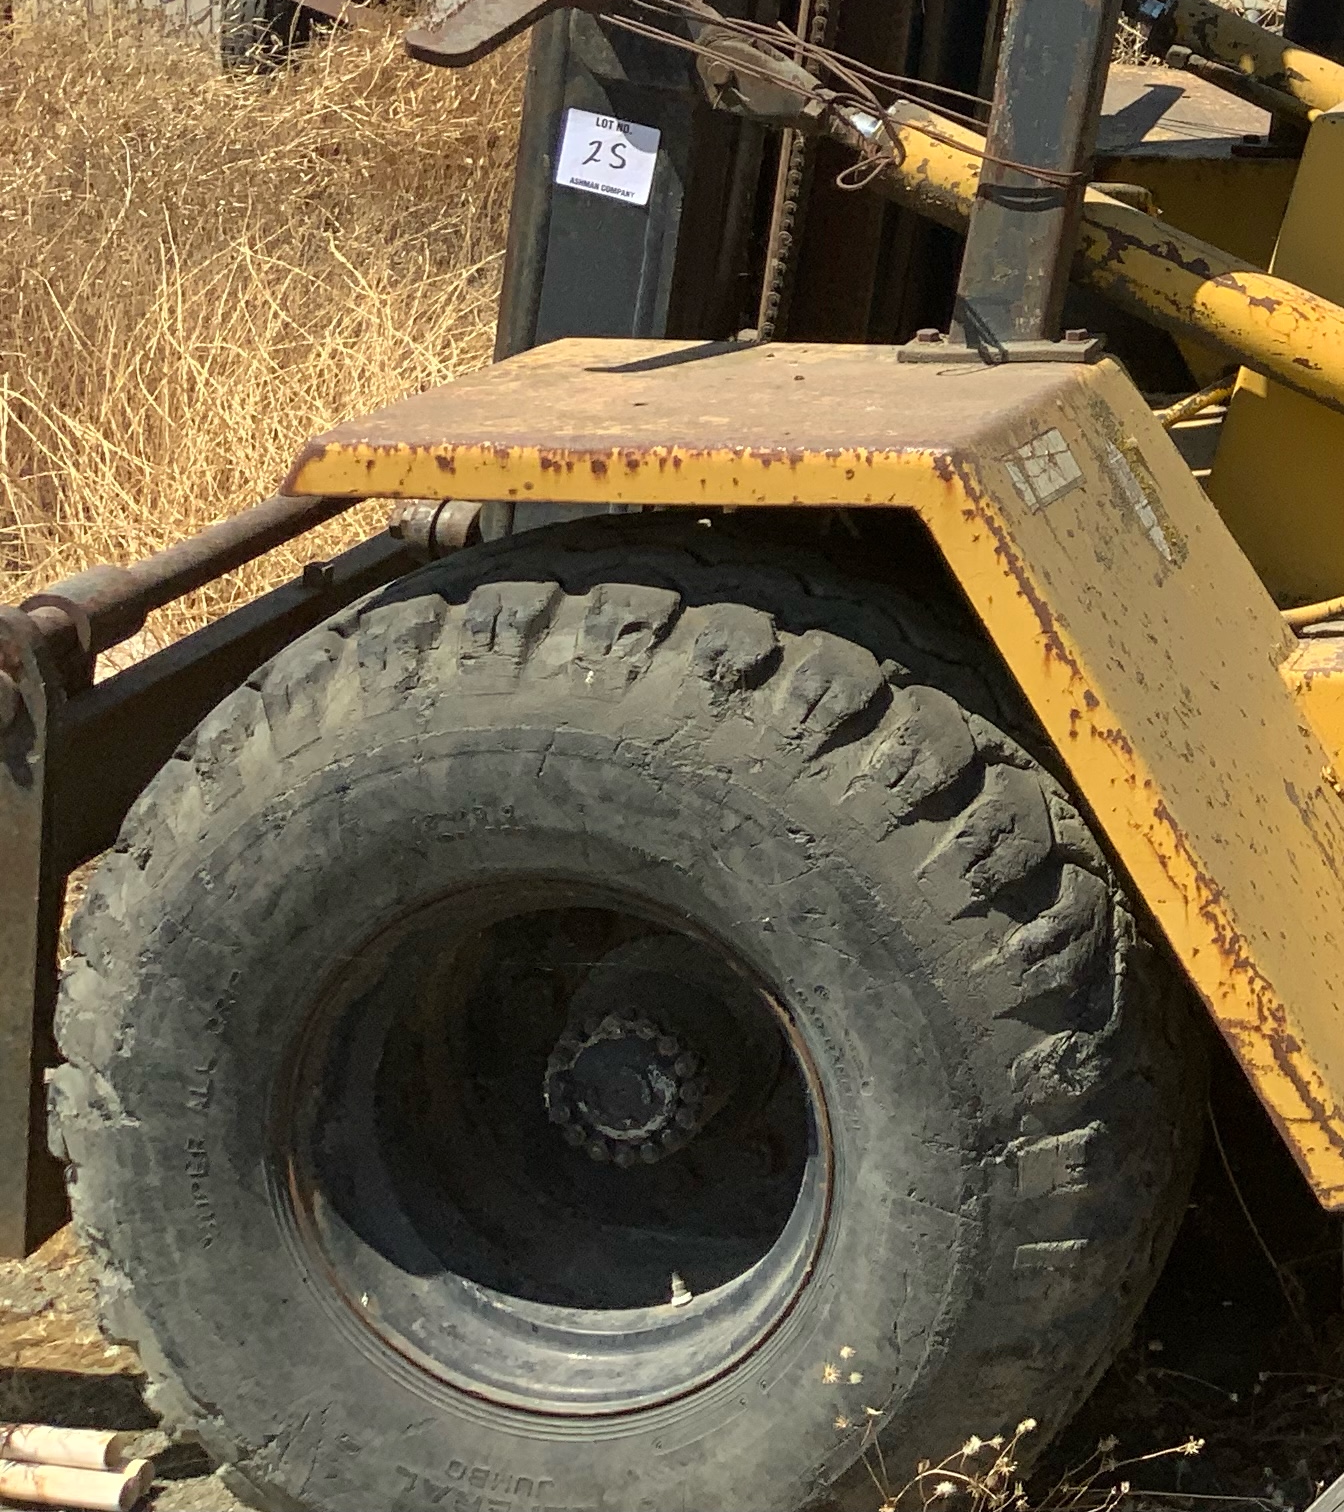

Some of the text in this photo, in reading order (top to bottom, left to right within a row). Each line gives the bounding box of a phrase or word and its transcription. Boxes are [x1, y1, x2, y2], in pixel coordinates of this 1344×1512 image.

[596, 118, 633, 135] LOT NO.
[581, 140, 627, 169] 25
[570, 177, 635, 198] ASHMAN COMPANY
[447, 1459, 554, 1497] JUMBO
